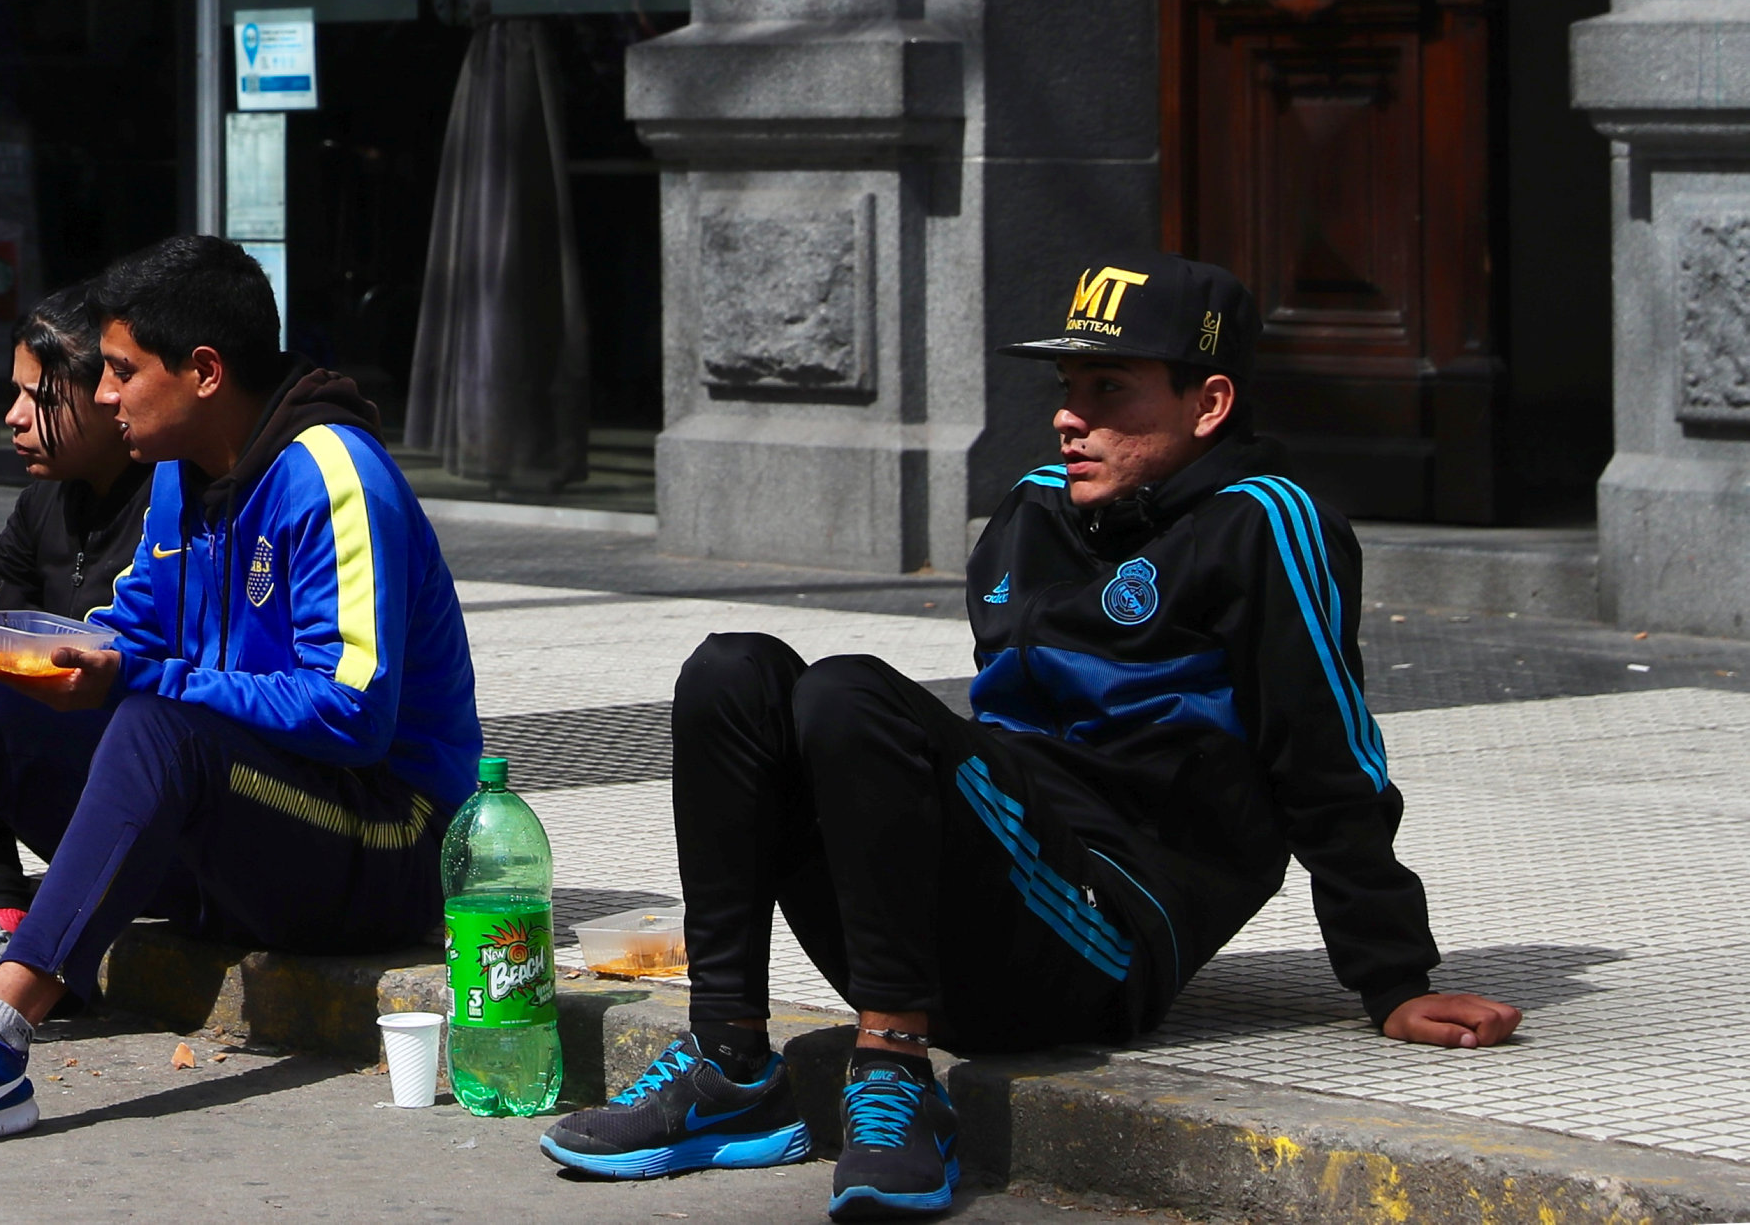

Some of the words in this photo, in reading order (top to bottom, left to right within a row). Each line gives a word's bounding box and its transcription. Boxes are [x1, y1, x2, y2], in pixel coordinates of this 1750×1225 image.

[481, 947, 506, 966] NEW
[490, 946, 544, 998] BEACH
[469, 989, 482, 1007] 3
[867, 1069, 896, 1082] NIKE
